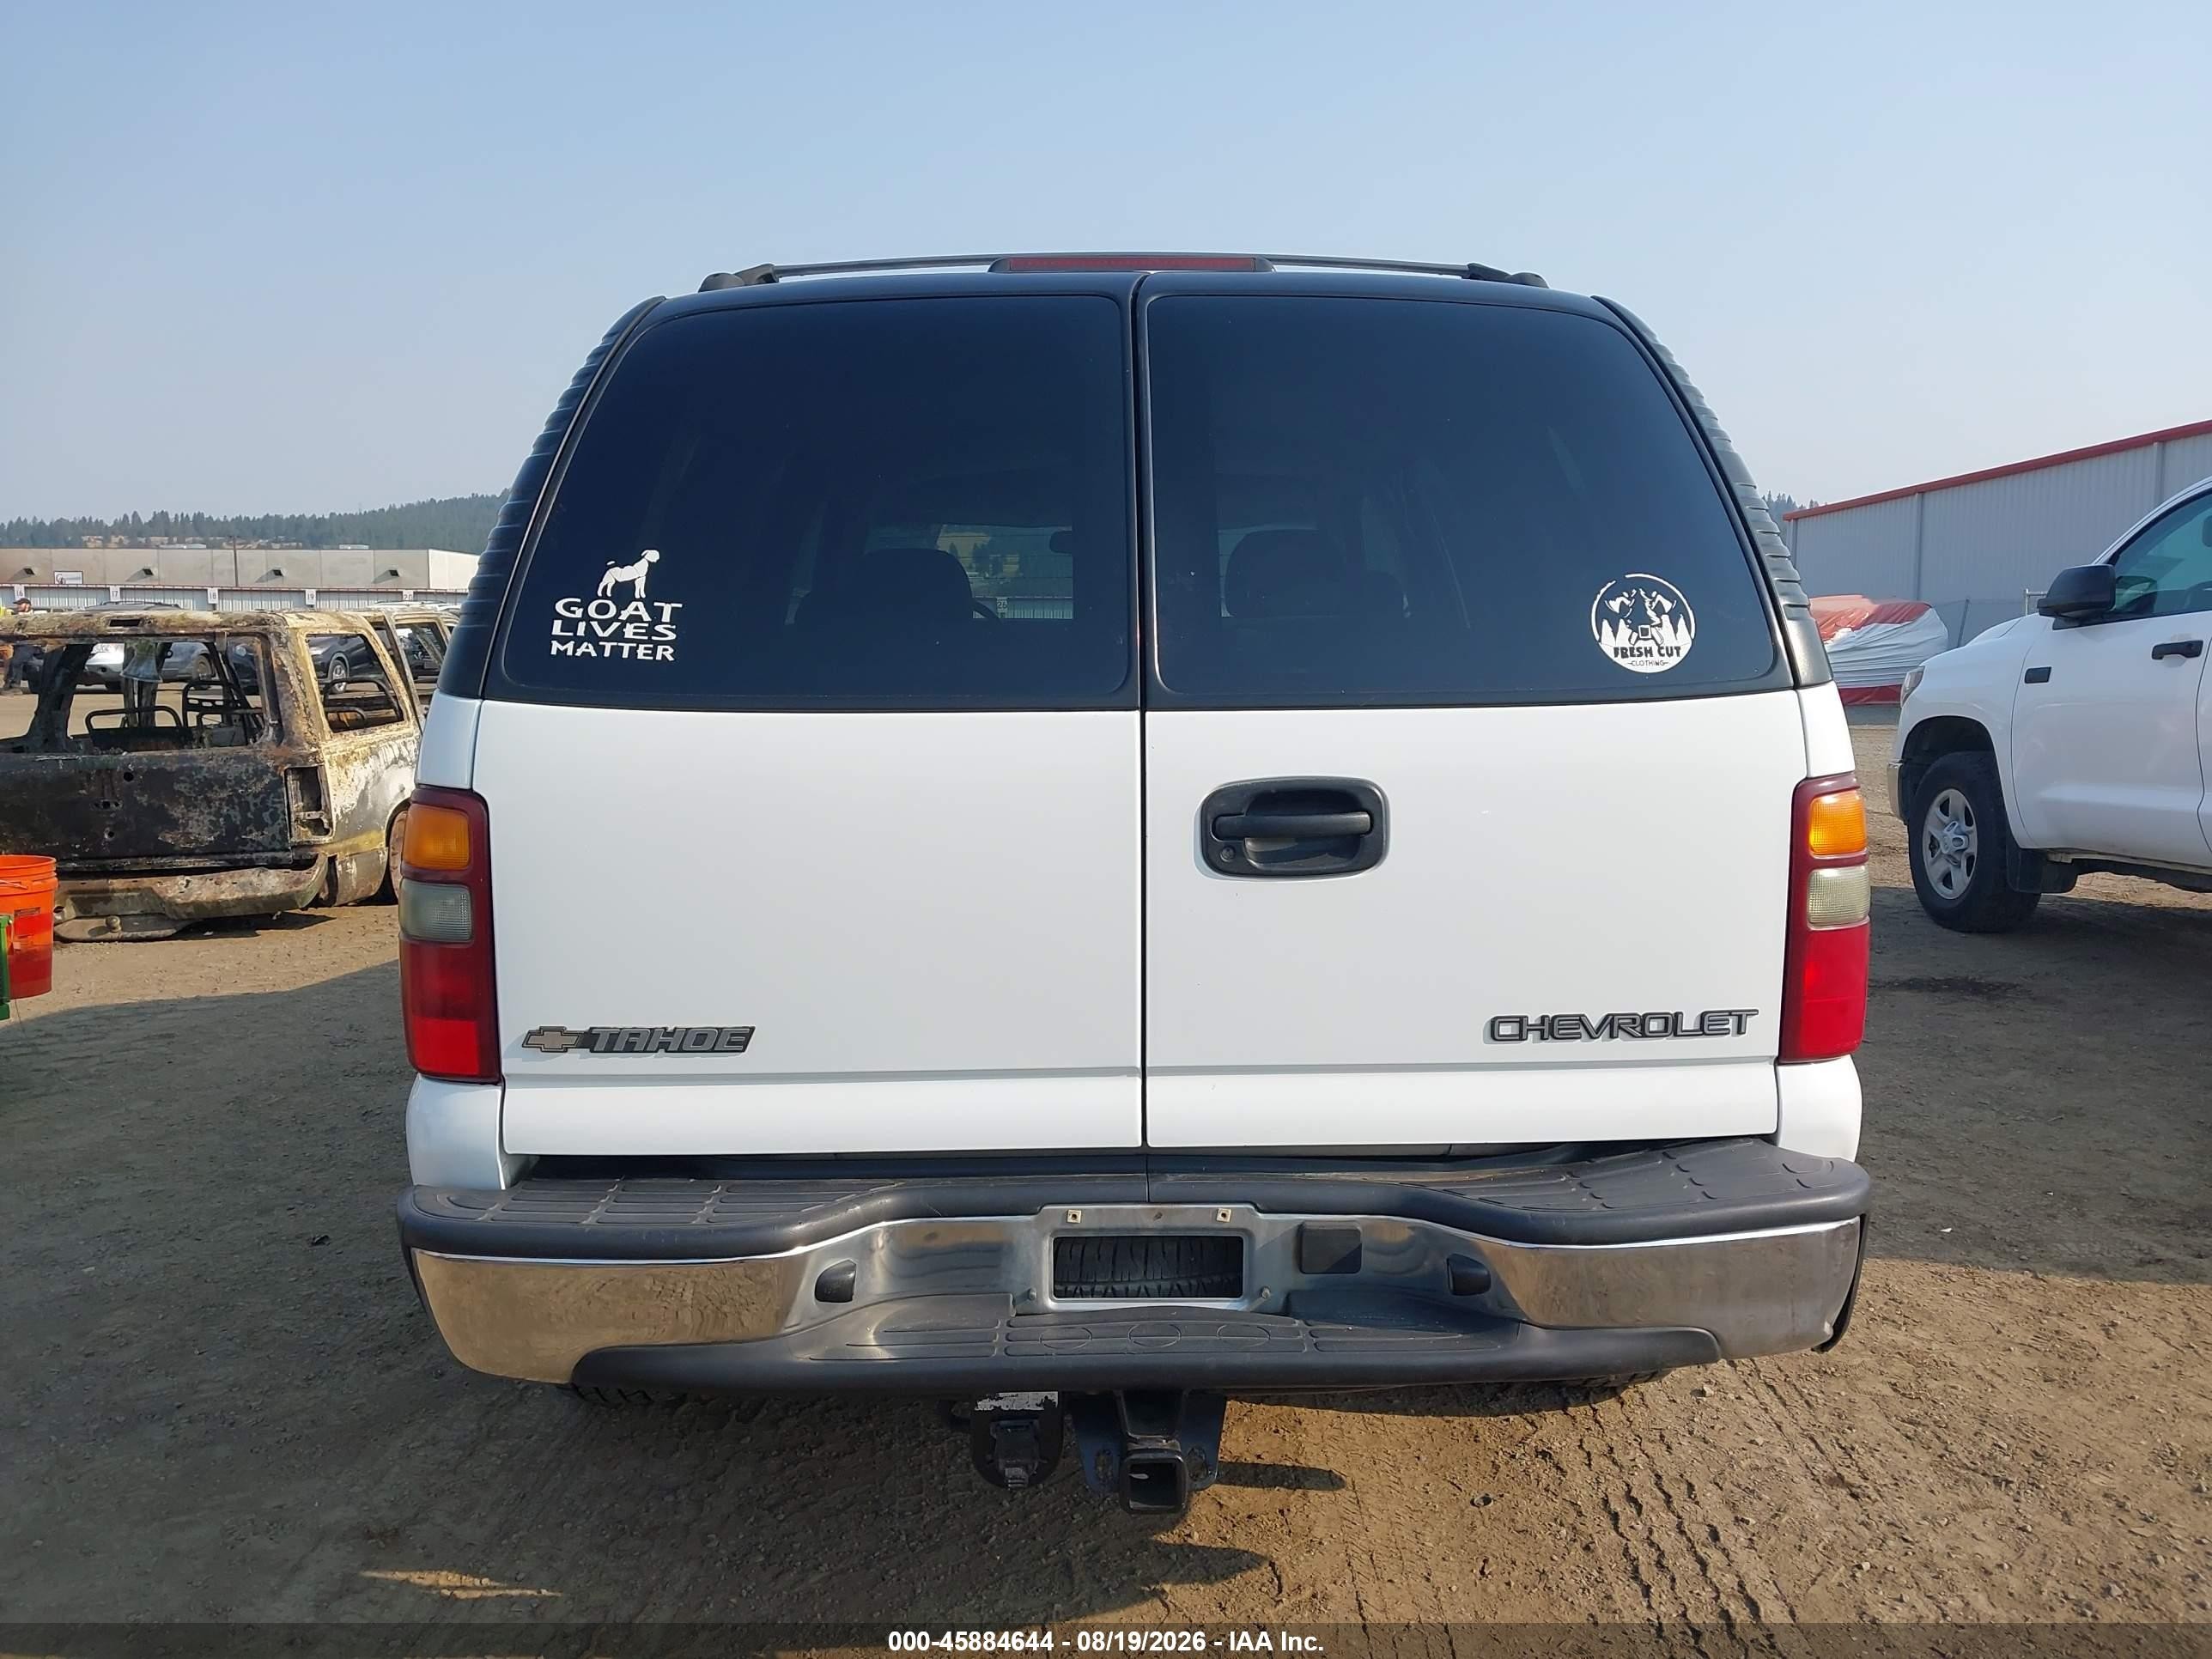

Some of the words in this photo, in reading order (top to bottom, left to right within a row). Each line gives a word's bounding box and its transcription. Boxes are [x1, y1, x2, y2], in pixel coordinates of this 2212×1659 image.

[555, 598, 683, 623] GOAT
[551, 619, 677, 641] LIVES
[550, 640, 675, 661] MATTER
[1613, 646, 1654, 659] FRESH
[1657, 645, 1681, 658] CUT
[1491, 1008, 1759, 1042] CHEVROLET
[591, 1026, 755, 1053] TAHOE
